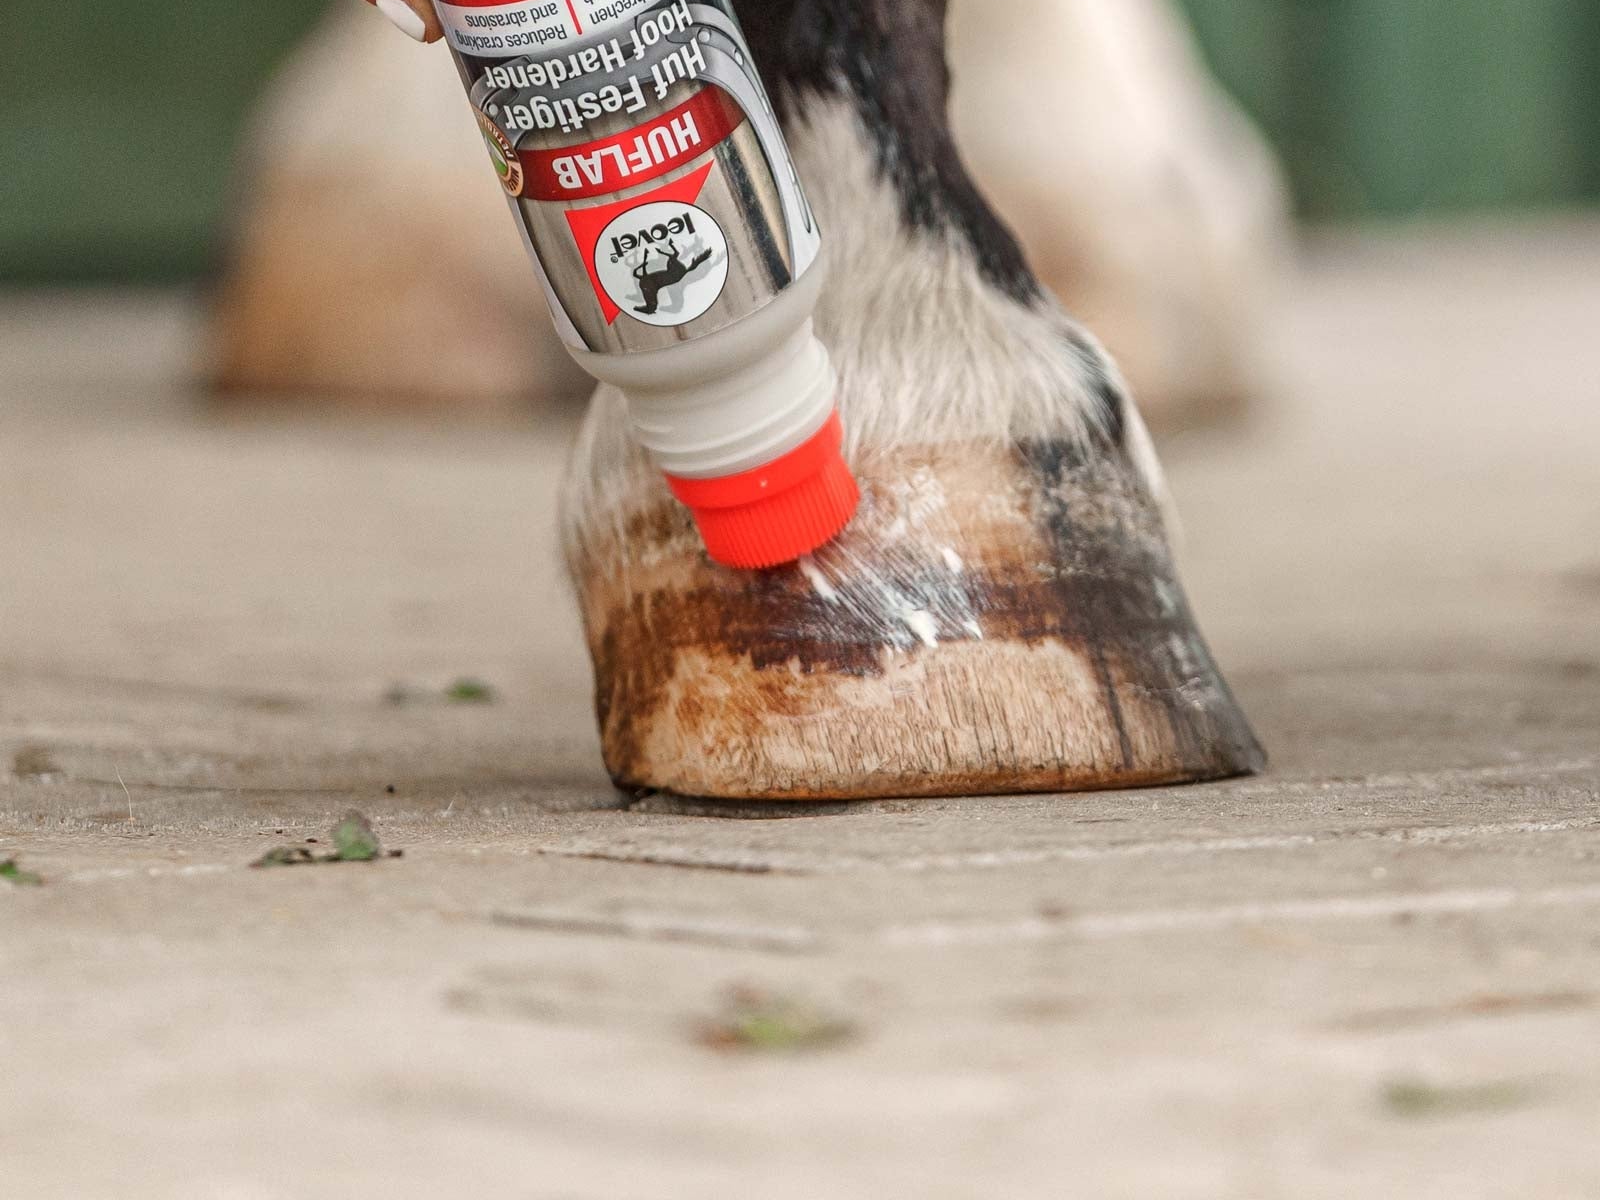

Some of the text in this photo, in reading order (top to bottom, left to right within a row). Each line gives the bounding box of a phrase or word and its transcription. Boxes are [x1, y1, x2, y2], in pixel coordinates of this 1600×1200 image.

[456, 25, 568, 51] Reduces cracking
[465, 3, 557, 31] and abrasions
[484, 39, 625, 88] Hardener
[501, 37, 707, 133] Huf Festiger
[550, 111, 701, 190] HUFLAB
